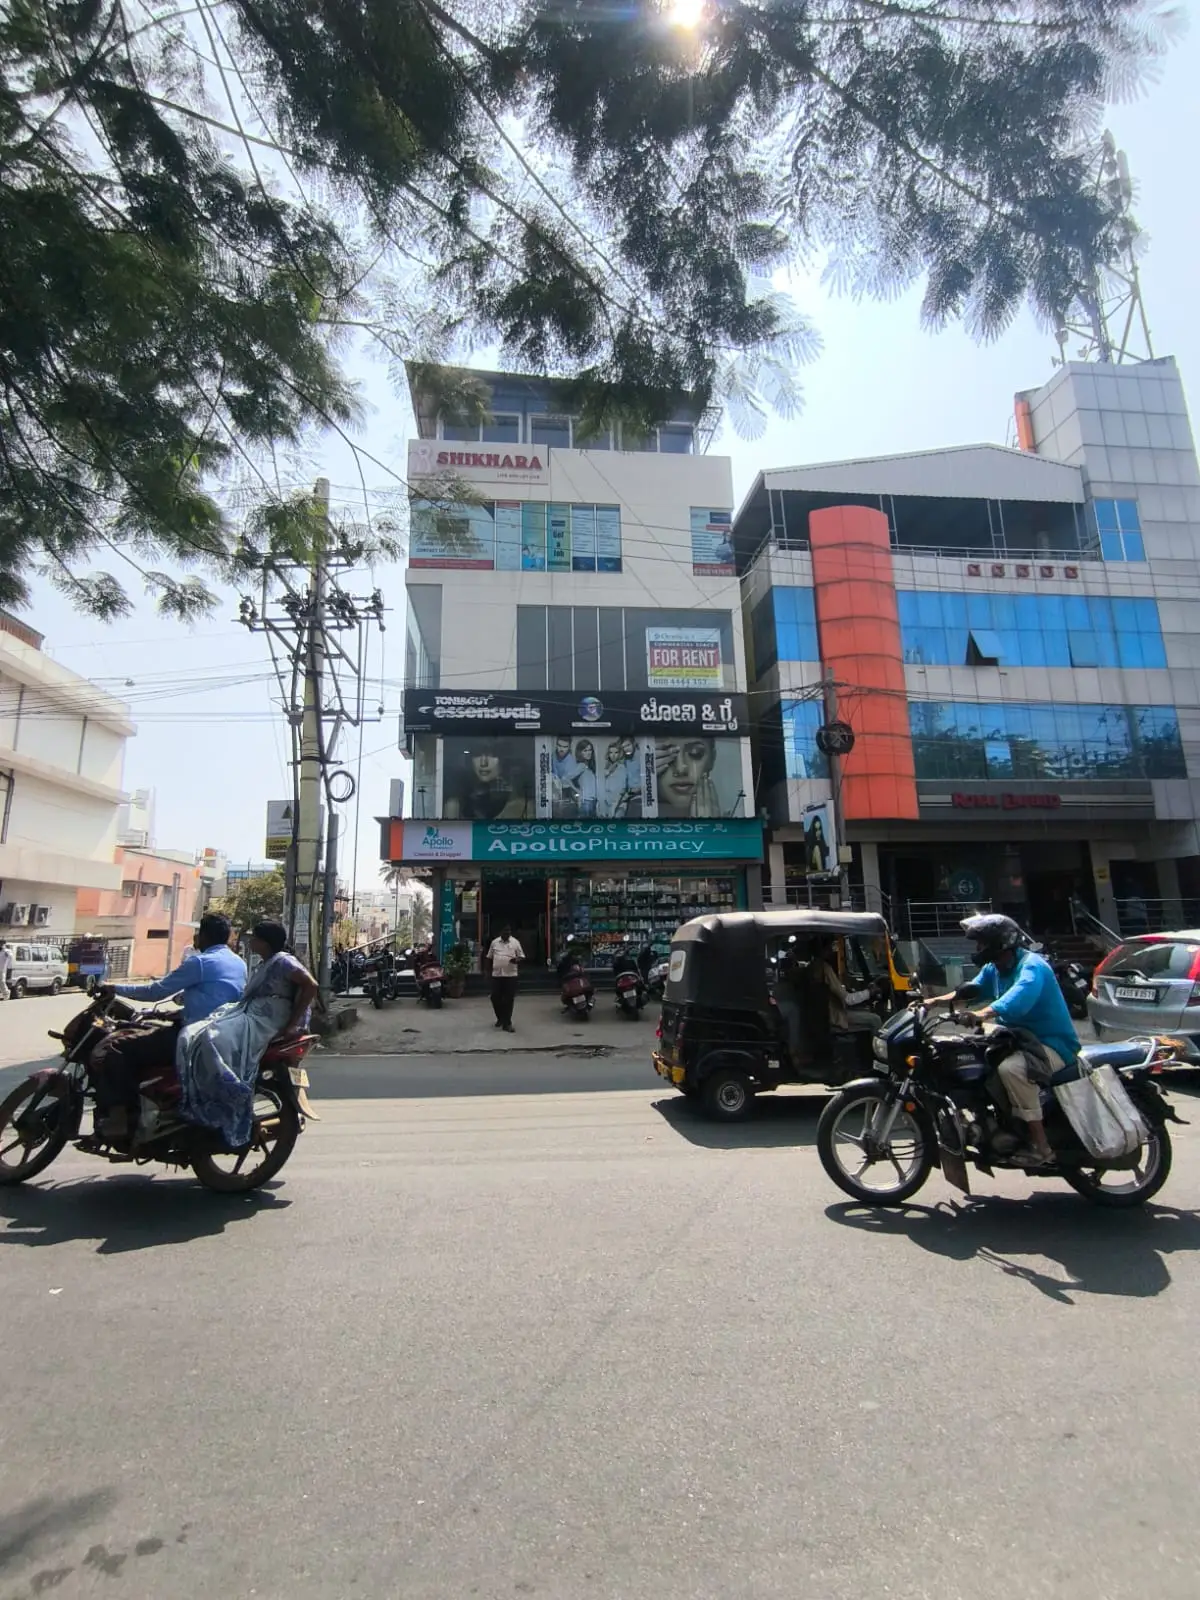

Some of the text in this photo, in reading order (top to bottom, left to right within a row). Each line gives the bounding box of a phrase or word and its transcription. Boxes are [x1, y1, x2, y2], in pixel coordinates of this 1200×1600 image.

[436, 451, 542, 470] SHIKHARA
[654, 649, 716, 667] FOR RENT
[433, 703, 541, 719] essensuals
[640, 697, 697, 721] ಟೋನಿ
[702, 704, 715, 722] &
[422, 836, 454, 849] Apollo
